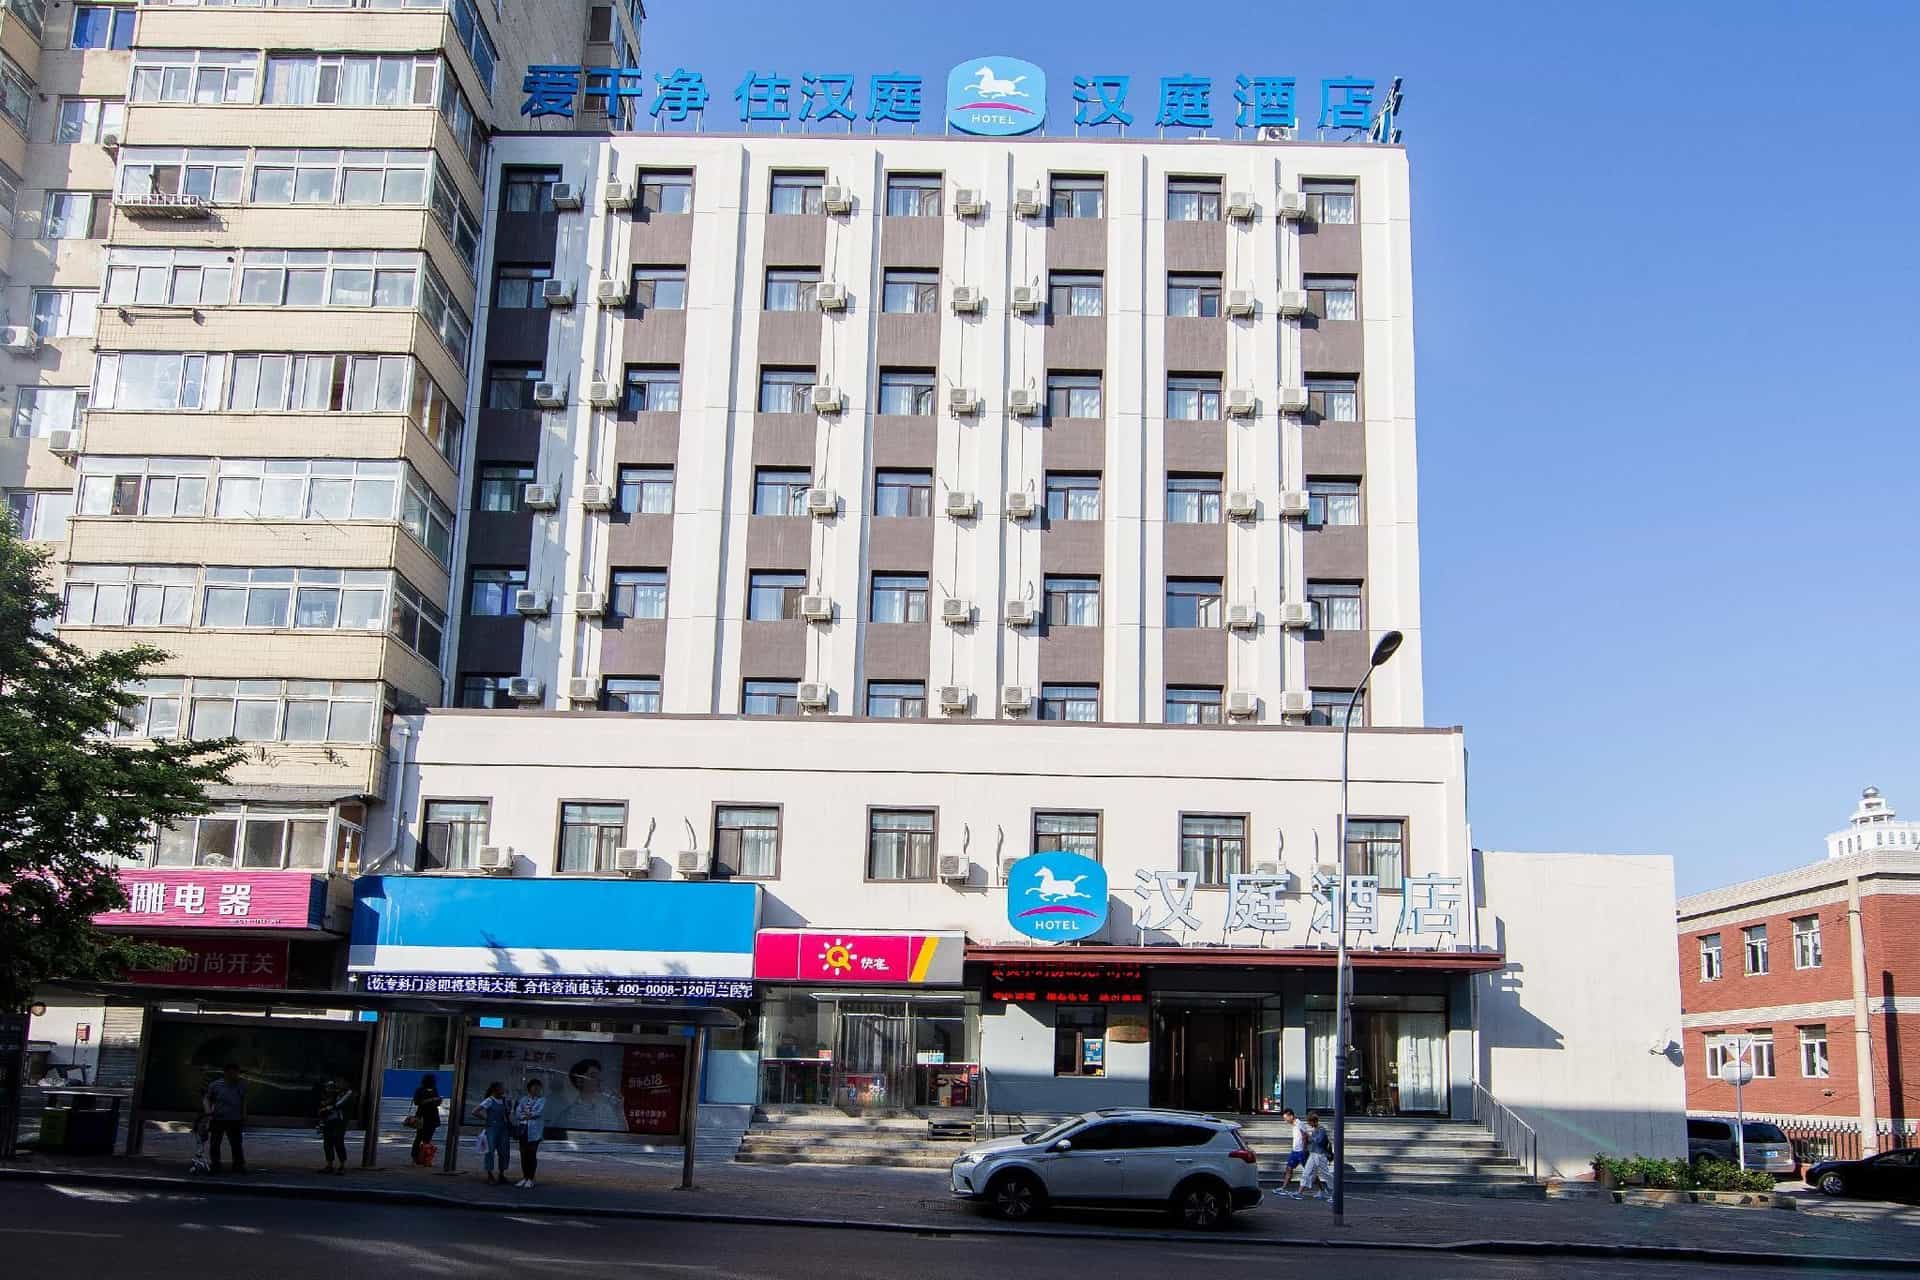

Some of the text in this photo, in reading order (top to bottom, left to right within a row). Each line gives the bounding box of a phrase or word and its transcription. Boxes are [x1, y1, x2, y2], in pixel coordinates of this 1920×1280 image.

[520, 64, 922, 123] 爱干净 住汉庭
[1073, 74, 1376, 128] 汉庭酒店
[971, 114, 1016, 125] HOTEL
[1135, 868, 1464, 935] 汉庭酒店
[1034, 920, 1080, 931] HOTEL
[860, 957, 890, 970] 快客
